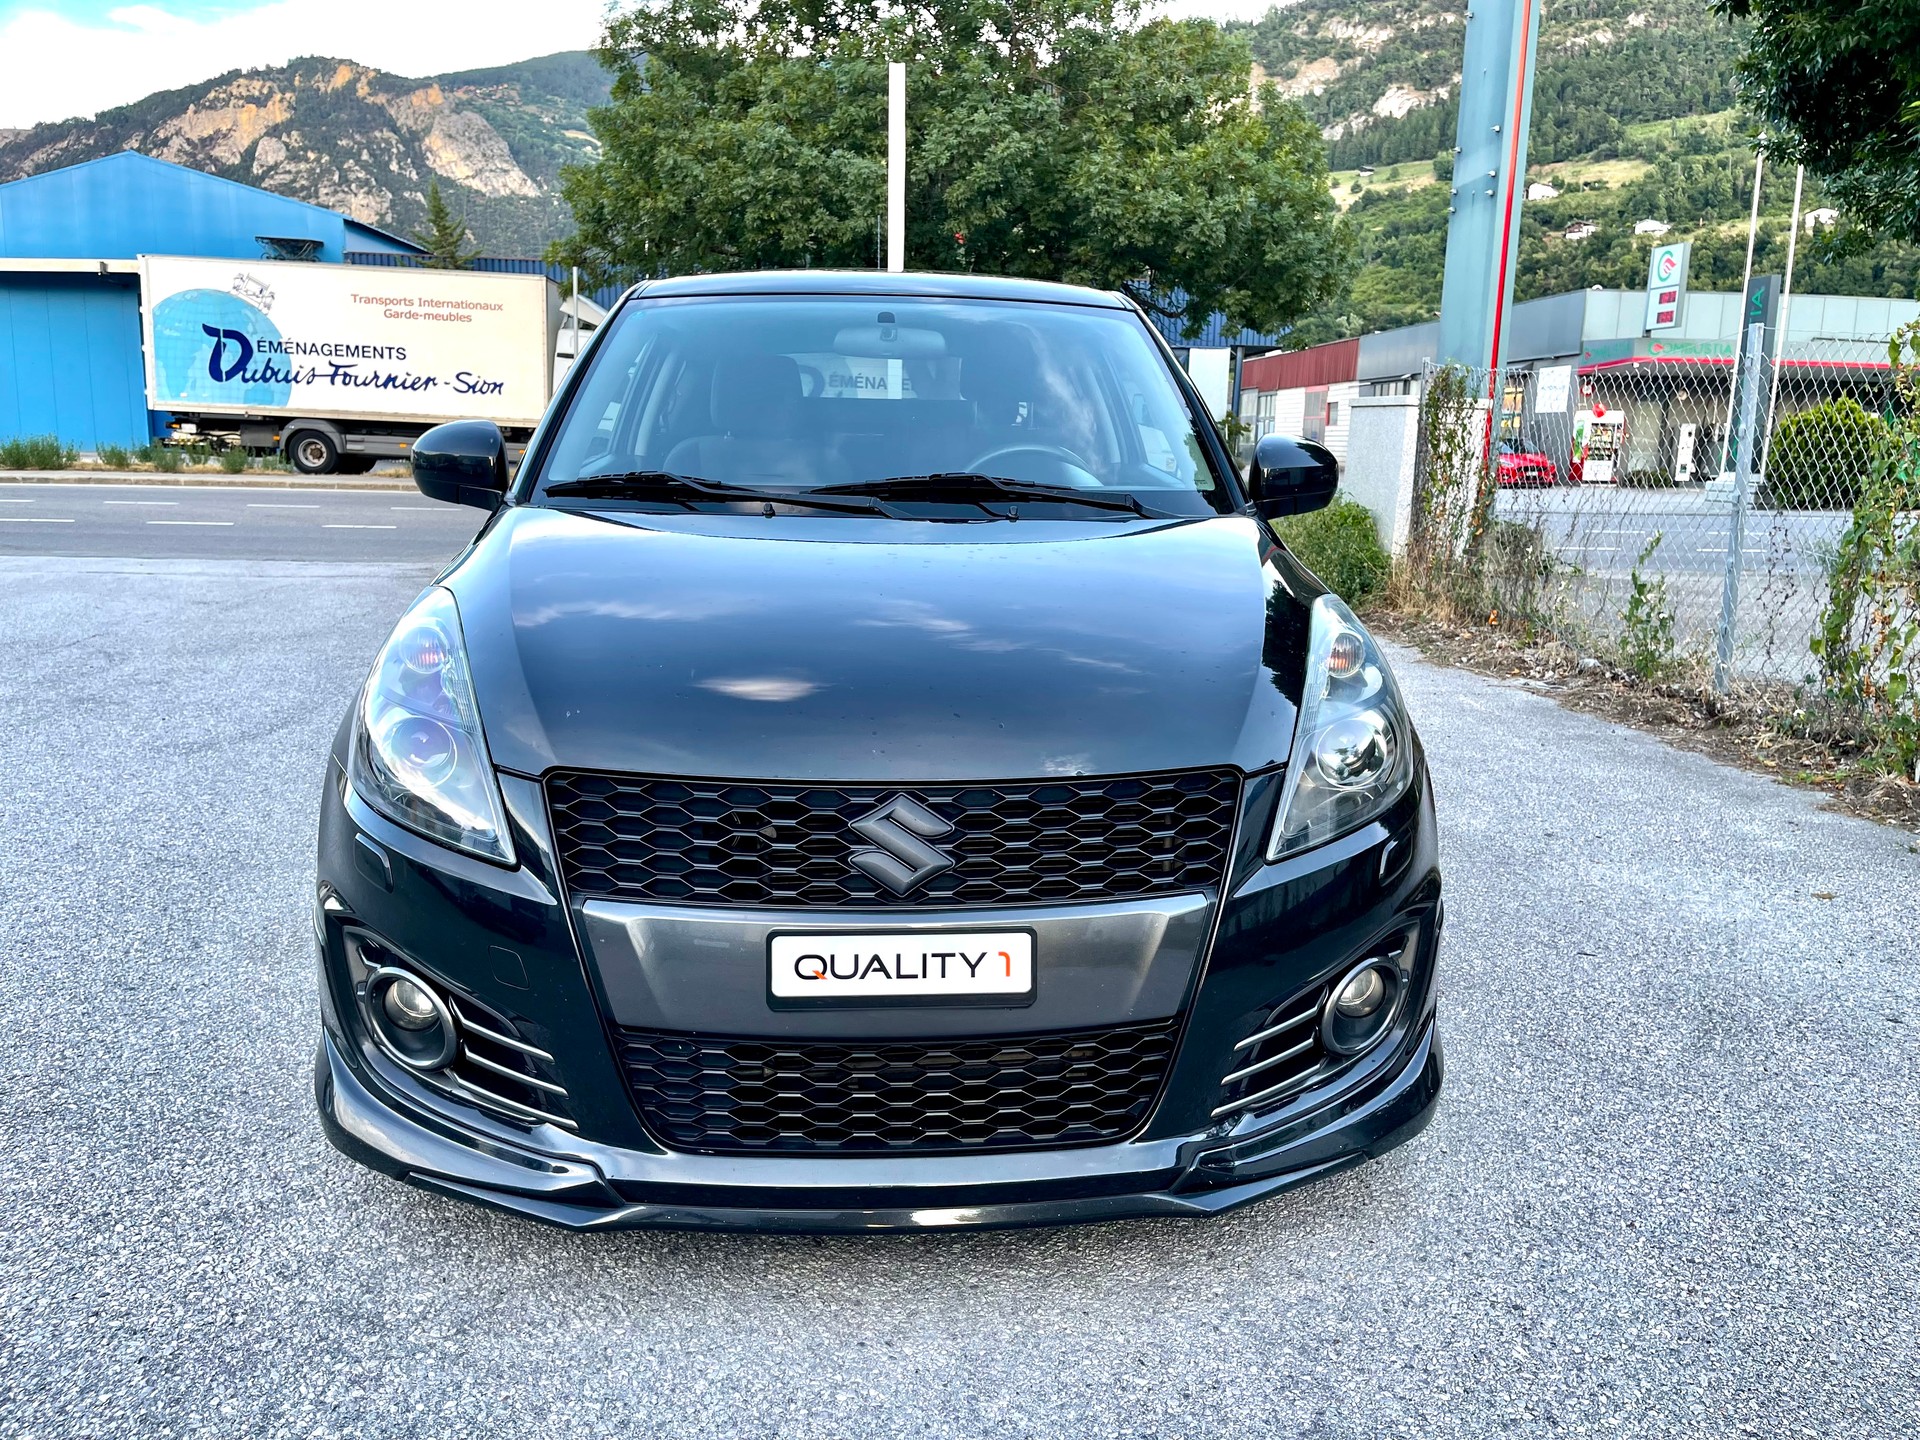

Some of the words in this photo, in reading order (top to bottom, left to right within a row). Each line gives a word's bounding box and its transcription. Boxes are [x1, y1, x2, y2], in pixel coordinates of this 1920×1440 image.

[351, 294, 415, 307] Transports
[418, 297, 504, 312] Internationaux
[383, 308, 473, 323] Garde-meubles
[453, 371, 504, 395] Sion
[794, 952, 988, 981] QUALITY
[998, 951, 1011, 977] 1
